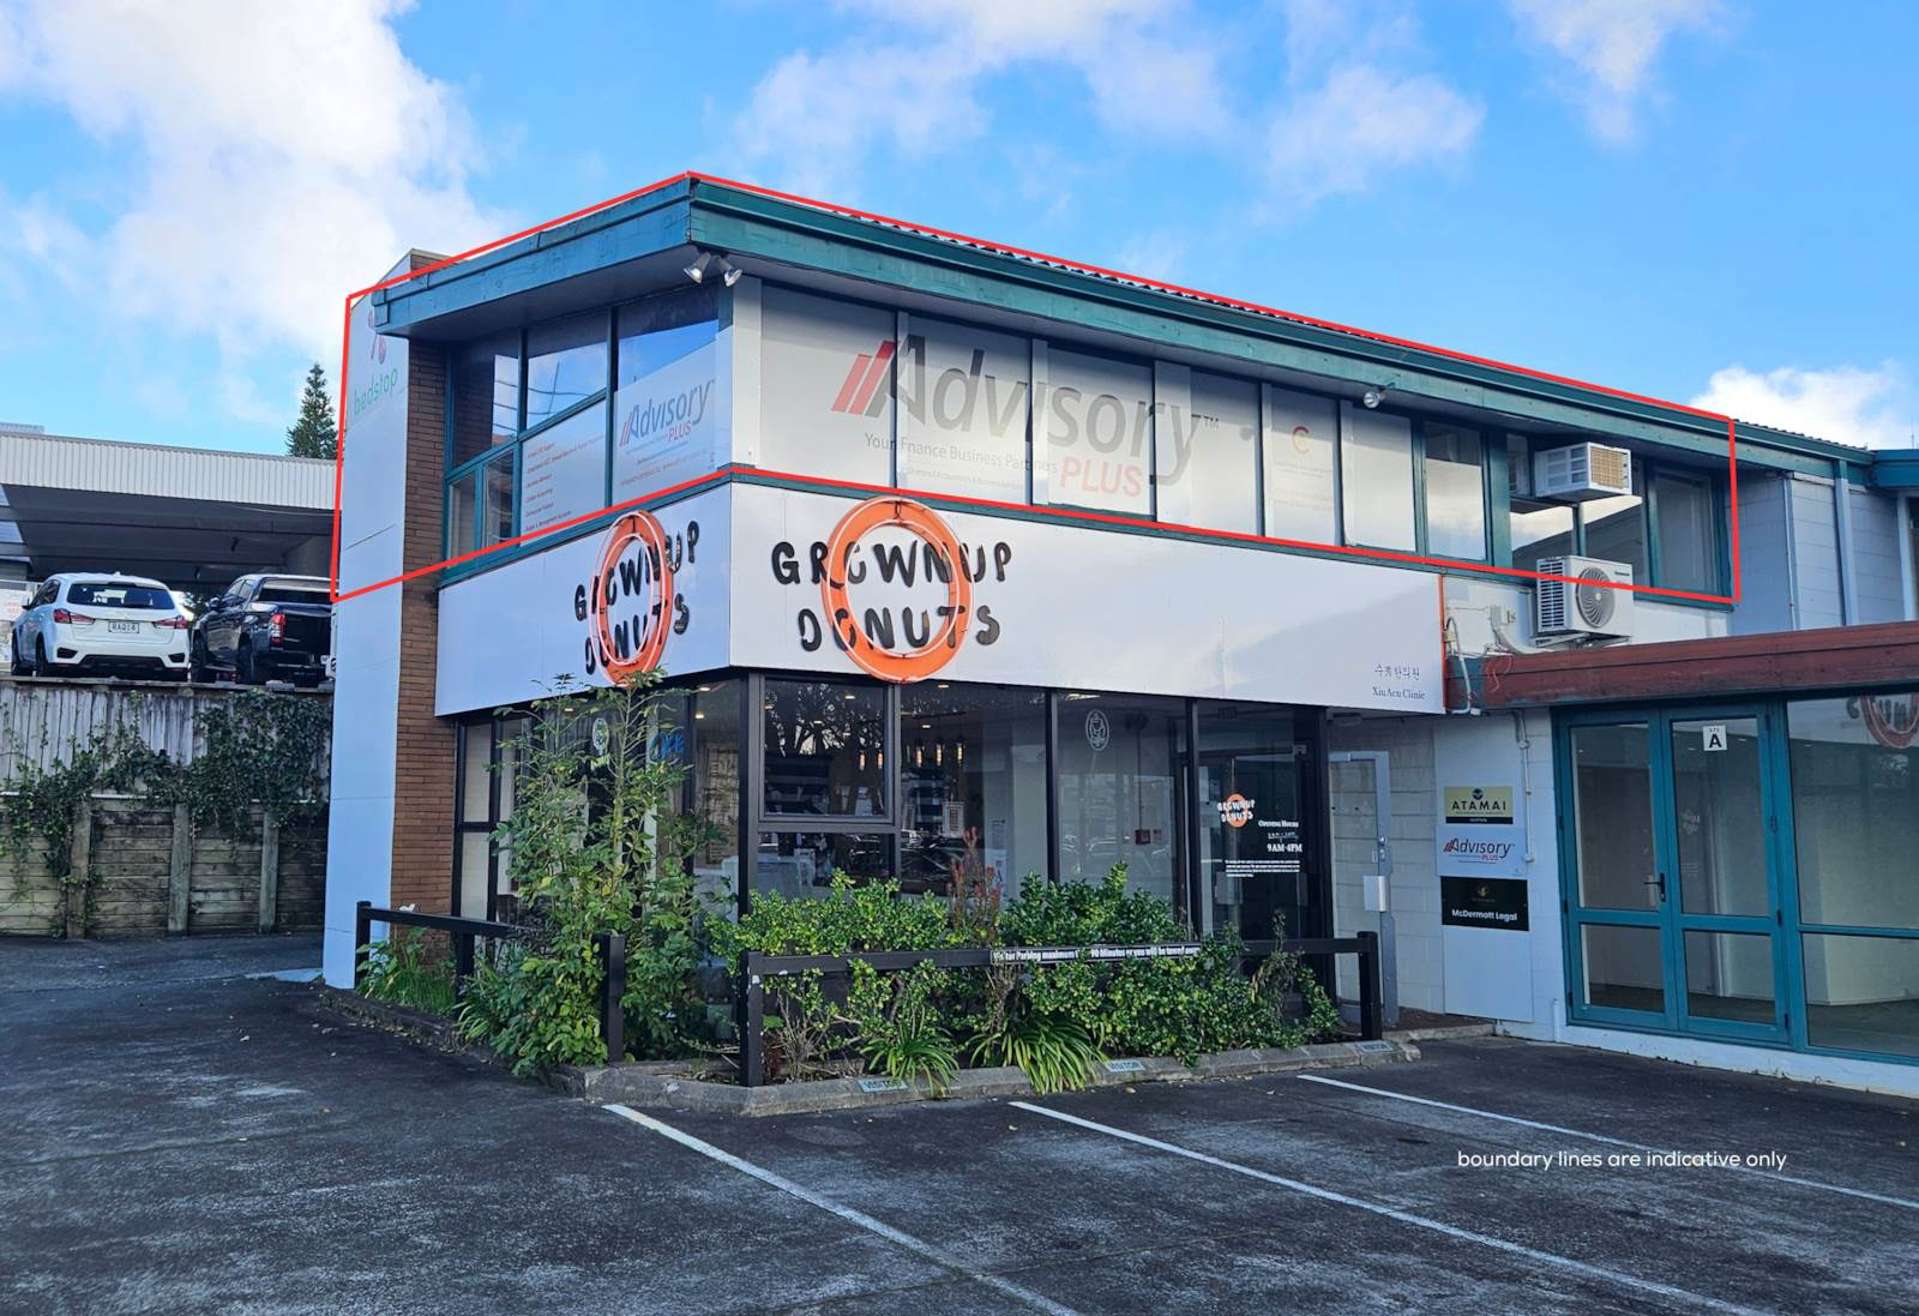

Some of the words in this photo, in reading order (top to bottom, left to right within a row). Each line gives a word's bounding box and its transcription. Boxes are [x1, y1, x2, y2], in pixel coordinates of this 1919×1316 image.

[626, 379, 714, 445] Advisory
[865, 432, 897, 450] Your
[1060, 456, 1143, 498] PLUS
[798, 604, 1000, 652] DONUTS
[1709, 733, 1722, 748] A
[1452, 801, 1506, 811] ATAMAI
[1452, 909, 1495, 920] McDermott
[1496, 911, 1518, 923] Legal
